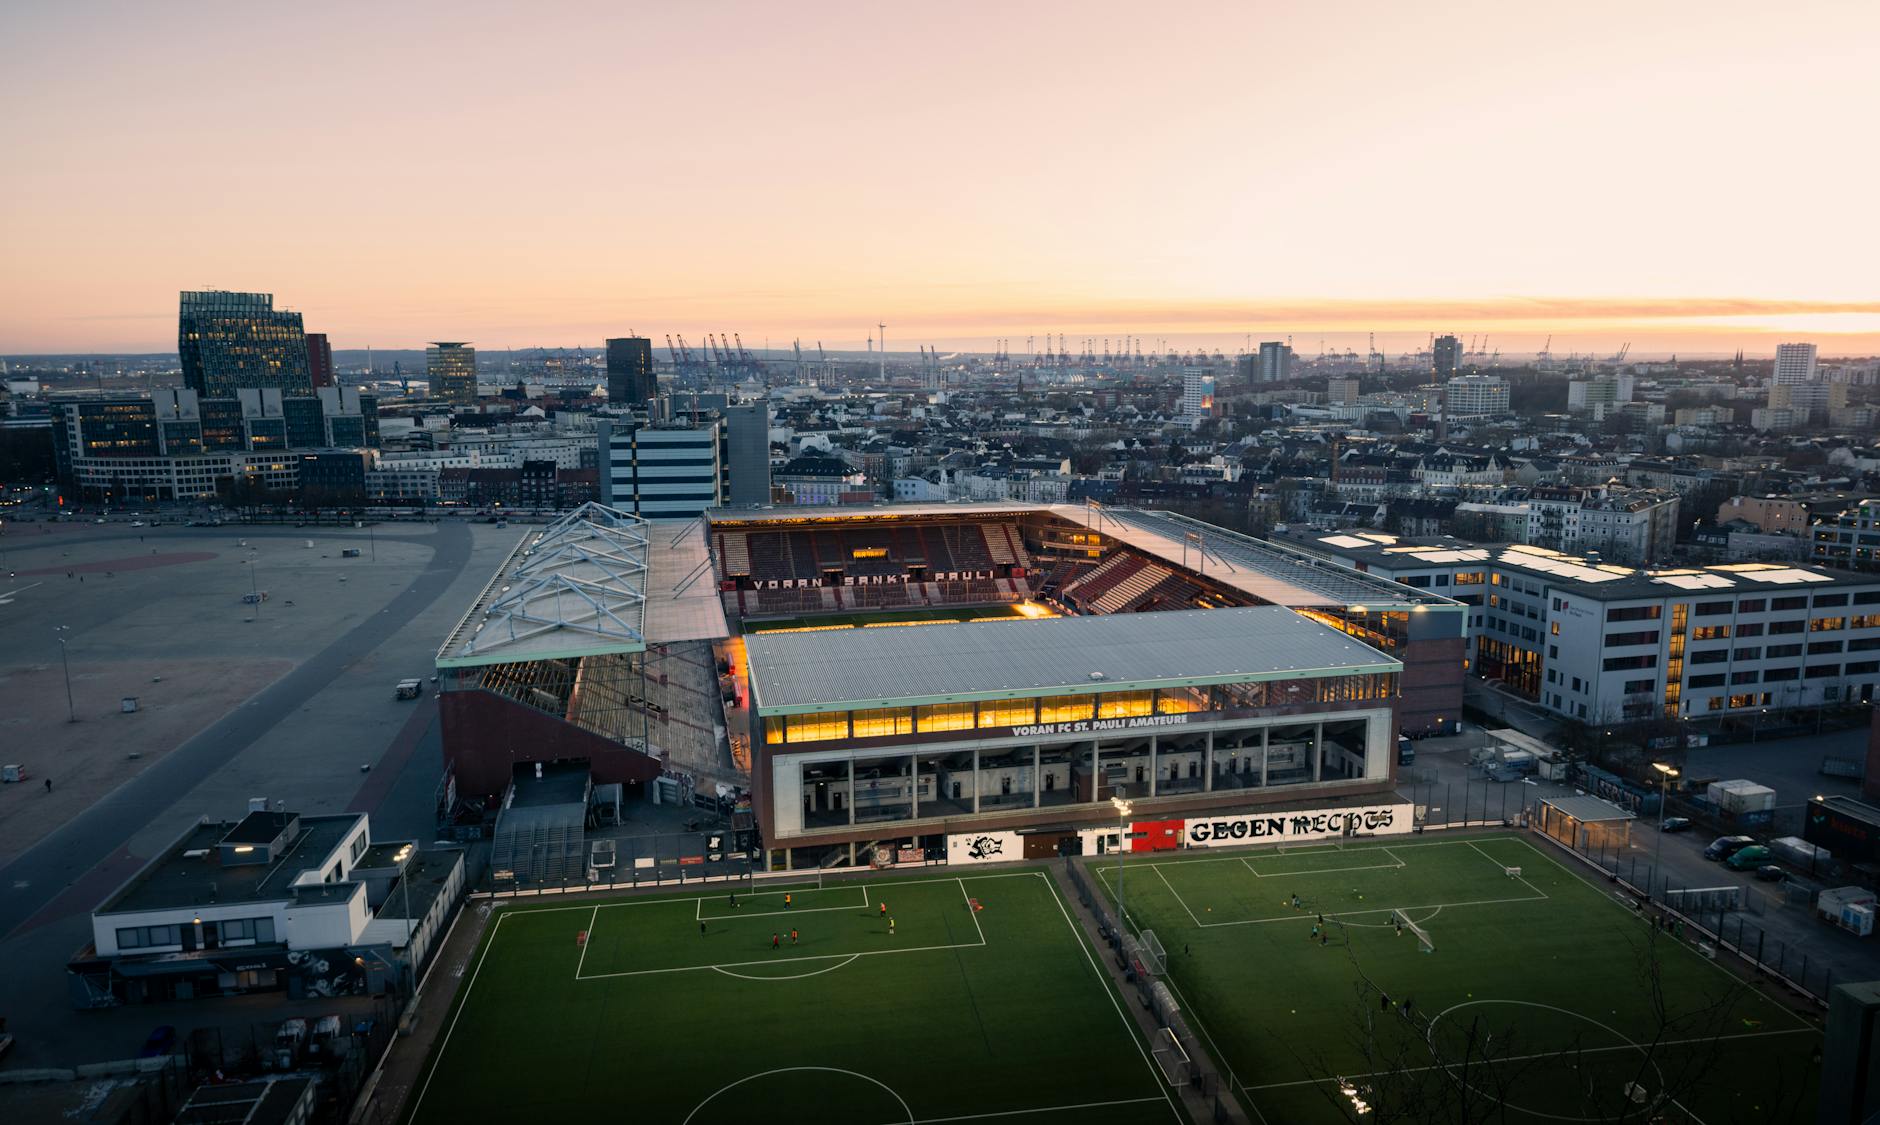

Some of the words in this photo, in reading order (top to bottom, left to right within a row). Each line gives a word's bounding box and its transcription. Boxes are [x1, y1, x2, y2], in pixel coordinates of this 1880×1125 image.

[754, 578, 823, 590] VORAN
[844, 574, 911, 586] SANKT
[935, 571, 994, 582] PAULI
[1012, 725, 1053, 737] VORAN
[1058, 723, 1072, 732] FC
[1074, 721, 1089, 732] ST.
[1093, 718, 1126, 730] PAULI
[1128, 715, 1188, 728] AMATEURE
[1190, 817, 1285, 842] GEGEN
